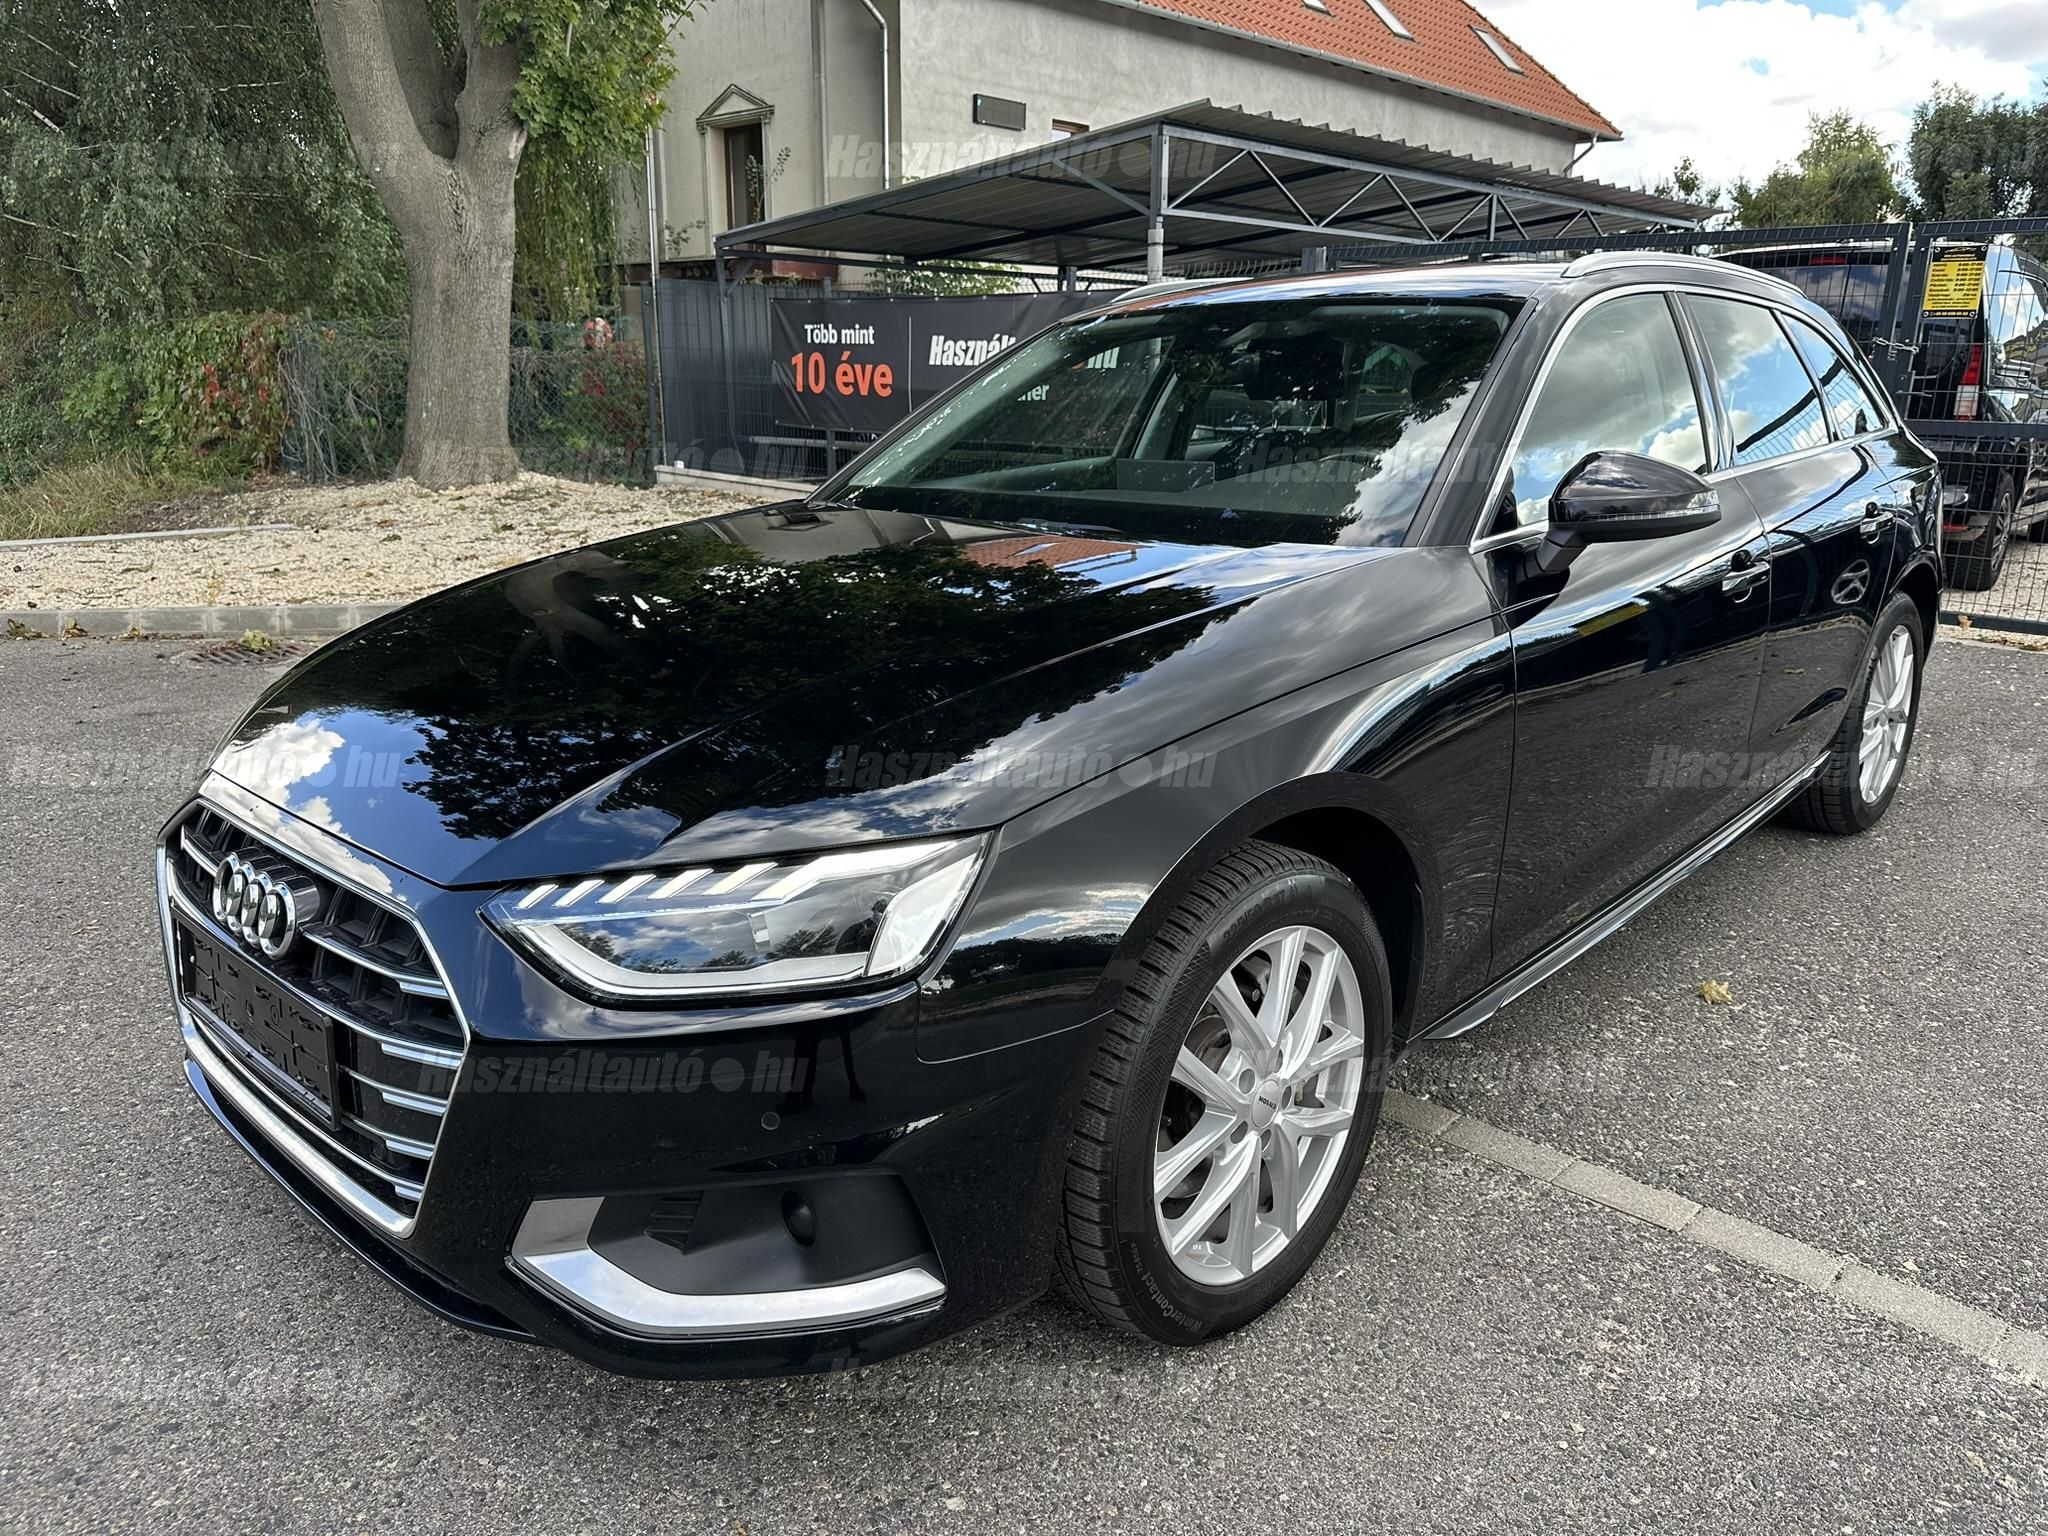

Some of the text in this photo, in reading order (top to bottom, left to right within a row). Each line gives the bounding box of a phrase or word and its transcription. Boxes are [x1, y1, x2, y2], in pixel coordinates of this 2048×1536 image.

[803, 323, 875, 345] Több mint
[791, 350, 894, 397] 10 éve
[1141, 1269, 1203, 1333] WinterContact
